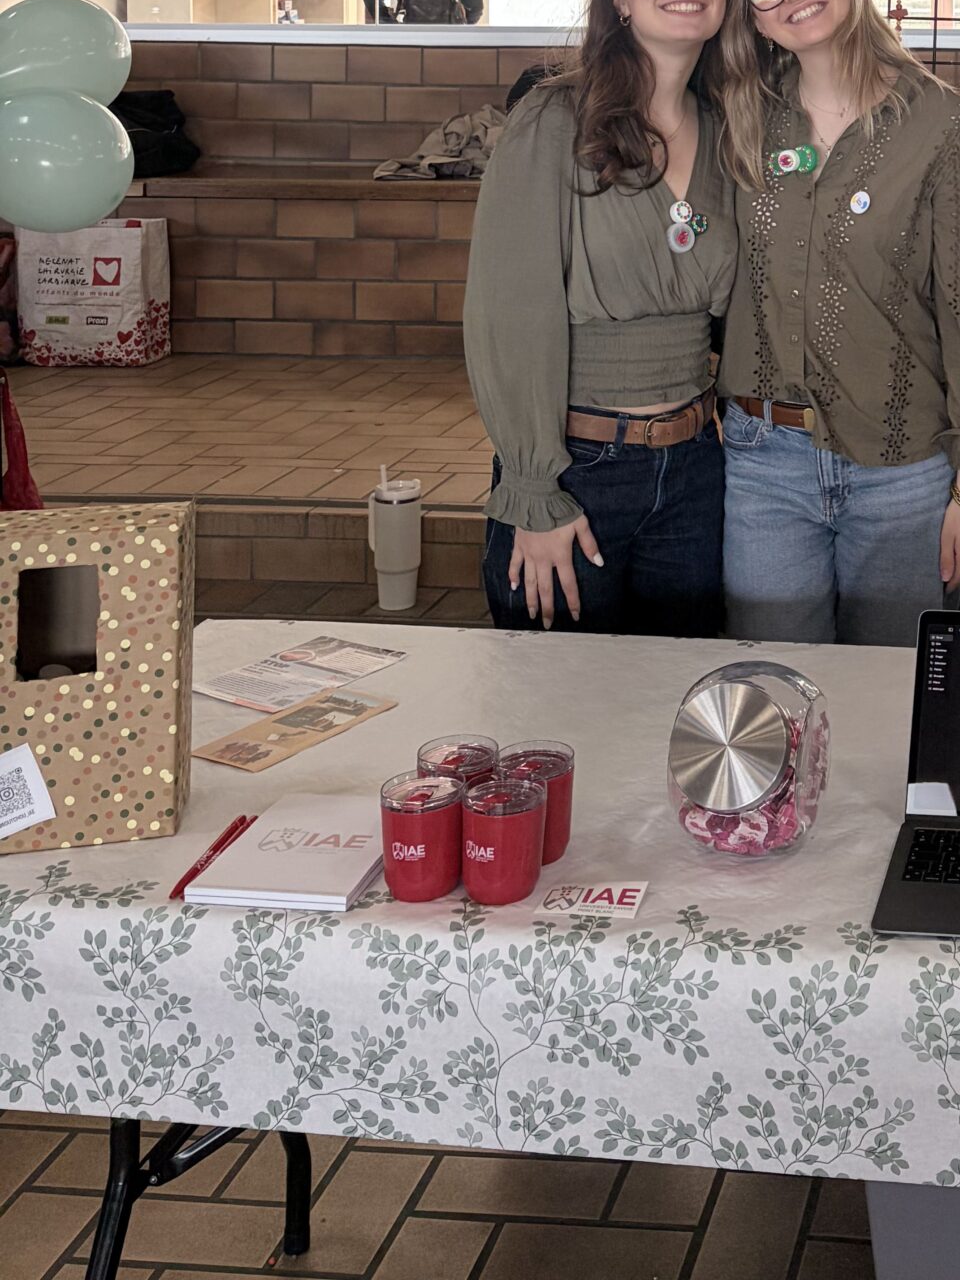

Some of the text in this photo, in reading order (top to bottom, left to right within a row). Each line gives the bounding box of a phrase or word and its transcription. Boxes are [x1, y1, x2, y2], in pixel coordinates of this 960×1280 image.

[260, 658, 290, 668] STOP
[303, 833, 373, 848] IAE
[405, 844, 425, 856] IAE
[476, 846, 494, 858] IAE
[581, 888, 642, 906] IAE
